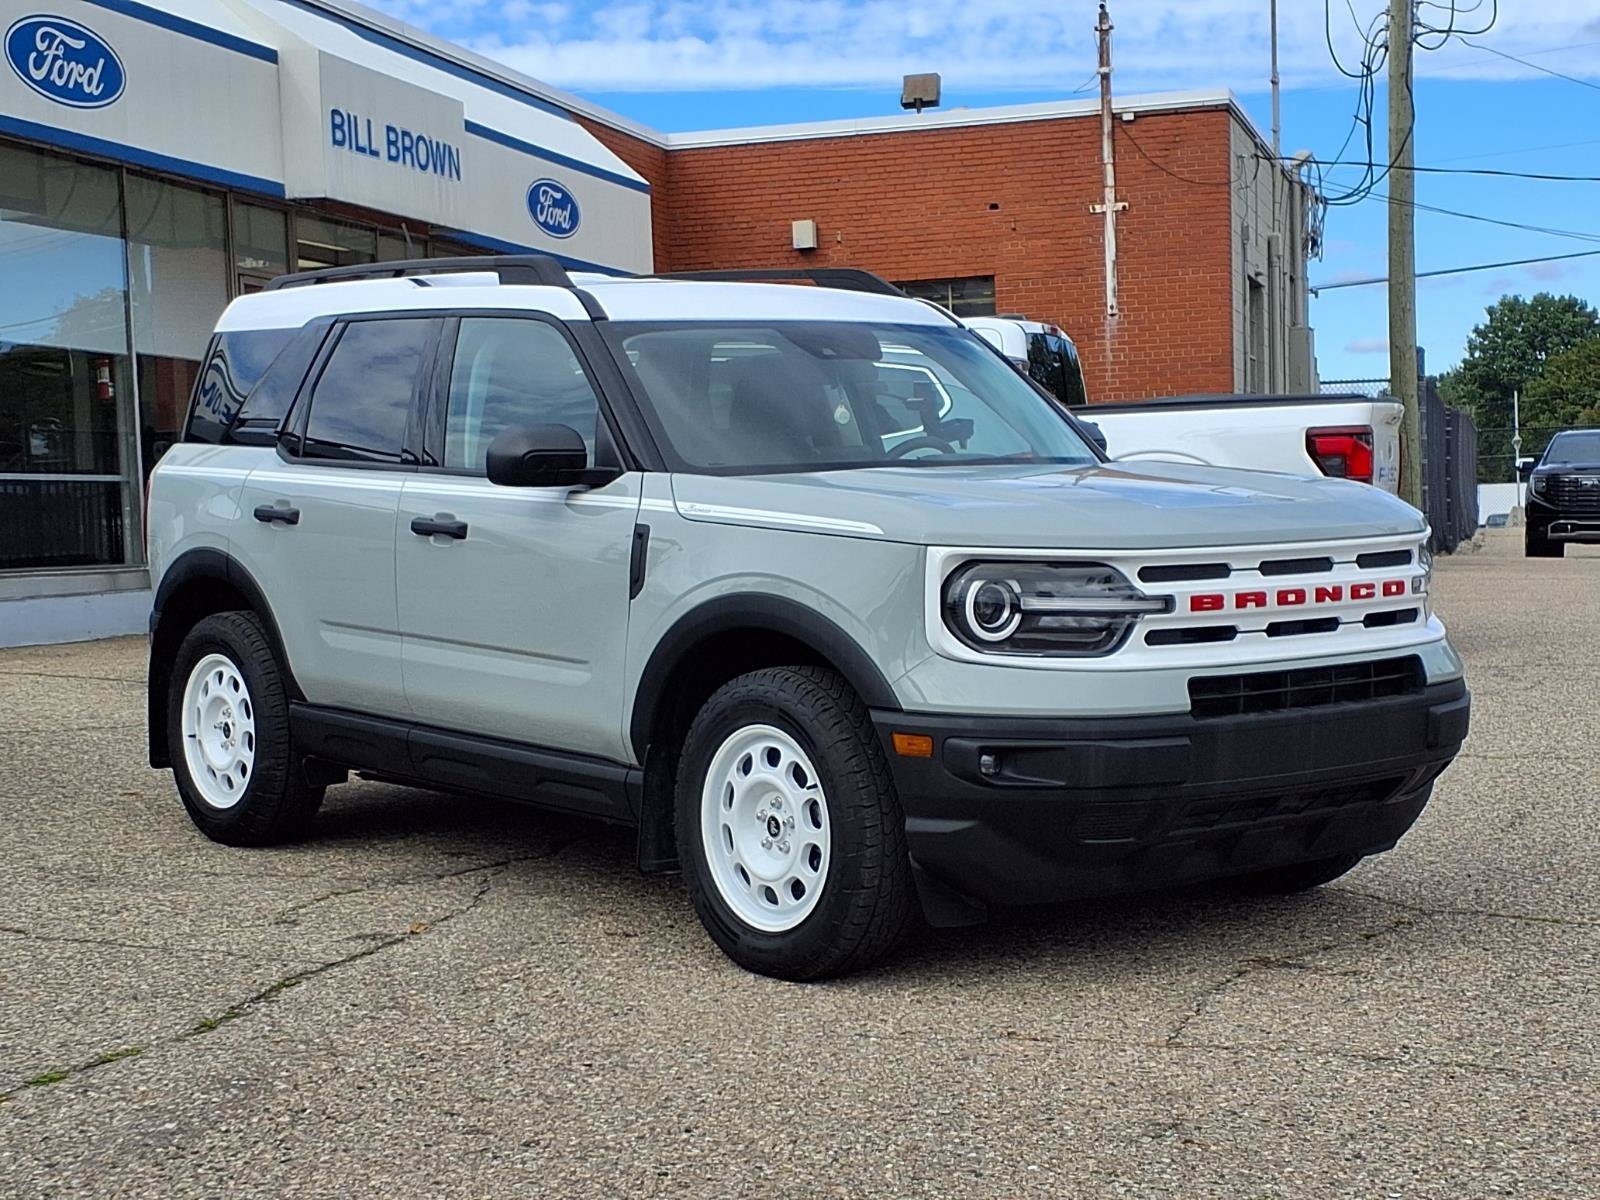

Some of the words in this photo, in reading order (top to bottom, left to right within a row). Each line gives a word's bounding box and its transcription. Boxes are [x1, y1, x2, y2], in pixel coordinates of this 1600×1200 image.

[28, 26, 105, 96] Ford
[330, 108, 380, 158] BILL
[385, 124, 461, 182] BROWN
[536, 186, 572, 230] Ford
[1190, 580, 1405, 612] BRONCO
